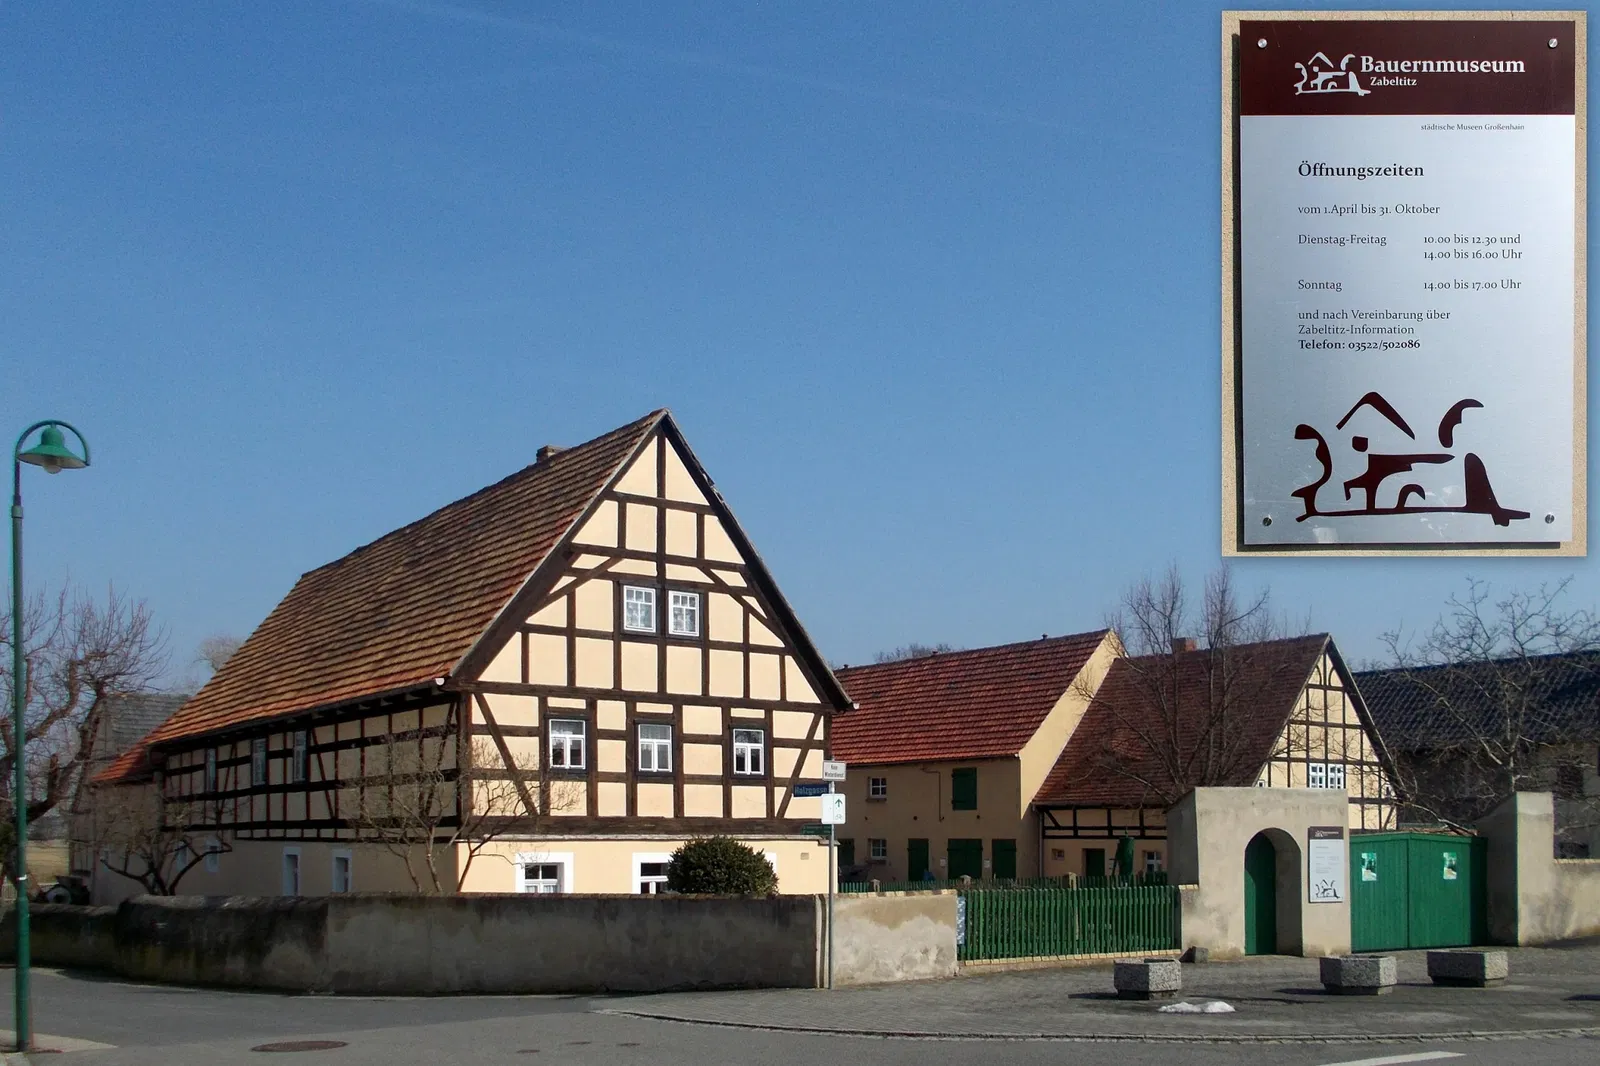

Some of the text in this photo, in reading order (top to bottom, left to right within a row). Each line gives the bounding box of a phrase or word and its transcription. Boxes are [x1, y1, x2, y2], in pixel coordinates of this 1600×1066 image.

[1360, 55, 1526, 73] Bauernmuseum
[1369, 76, 1418, 87] Zabeltitz
[1420, 123, 1525, 131] städtische Museen Großenhain
[1298, 160, 1425, 180] Öffnungszeiten
[1298, 203, 1441, 217] vom 1.April bis 31. Oktober
[1298, 233, 1387, 248] Dienstag-Freitag
[1424, 233, 1521, 247] 10.00 bis 12.30 und
[1424, 248, 1523, 262] 14.00 bis 16.00 Uhr
[1298, 279, 1343, 293] Sonntag
[1424, 278, 1522, 292] 14.00 bis 17.00 Uhr
[1298, 309, 1451, 323] und nach Vereinbarung über
[1298, 323, 1415, 335] Zabeltitz-Information
[1298, 338, 1421, 352] Telefon: 03522/502086
